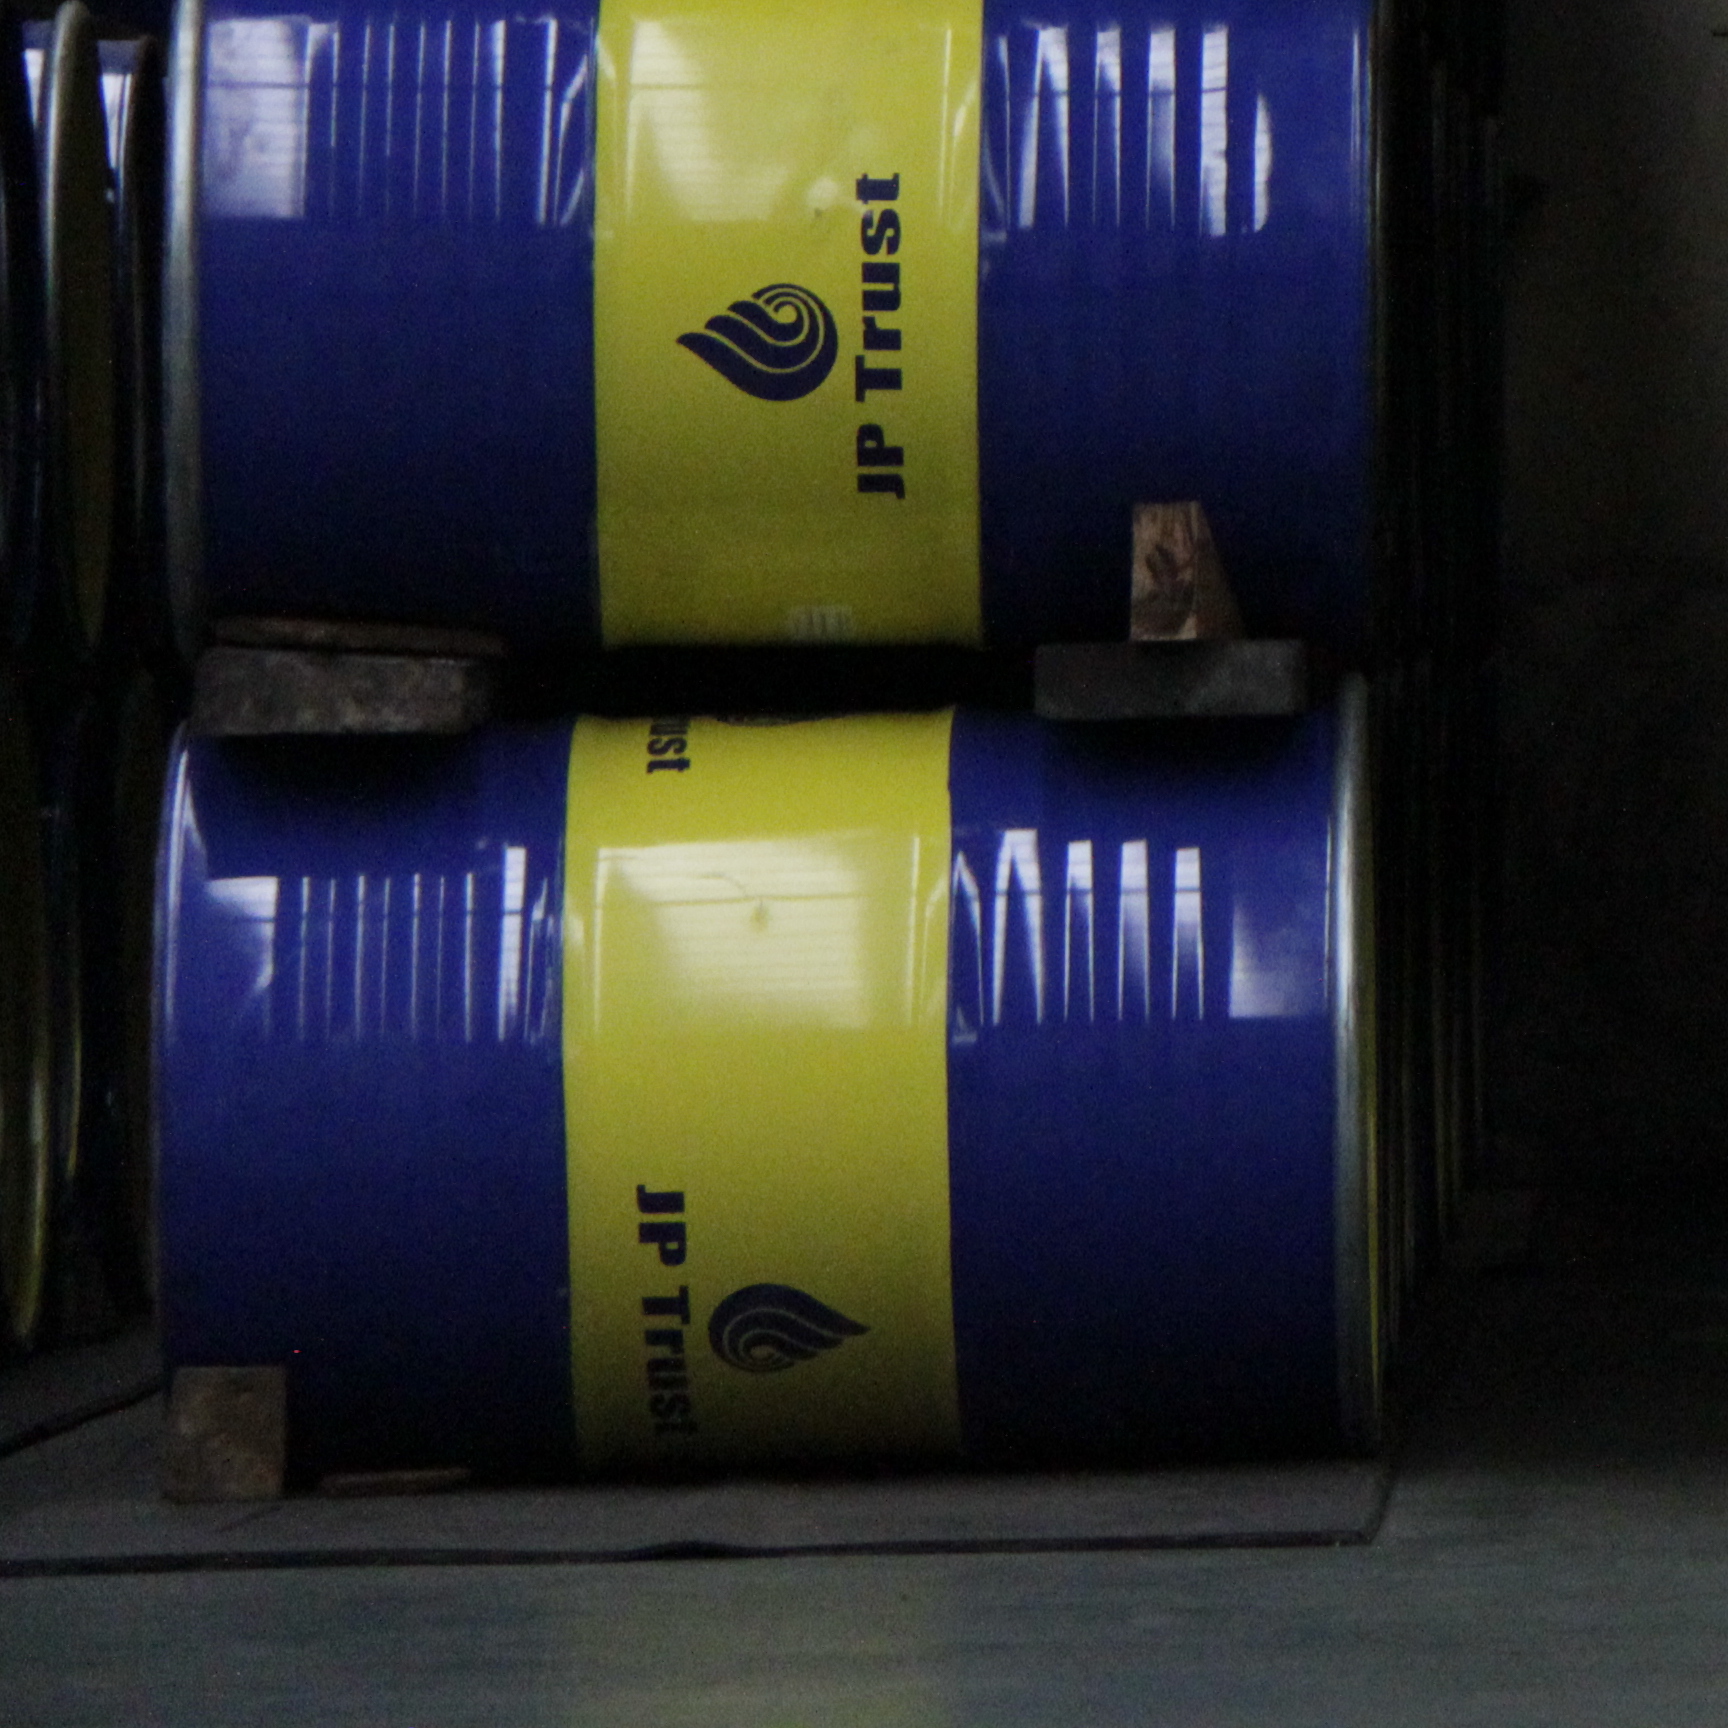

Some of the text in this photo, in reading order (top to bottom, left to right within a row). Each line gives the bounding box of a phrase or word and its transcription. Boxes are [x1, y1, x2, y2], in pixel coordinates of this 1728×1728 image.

[855, 172, 905, 500] JP Trust
[636, 1184, 686, 1266] JP
